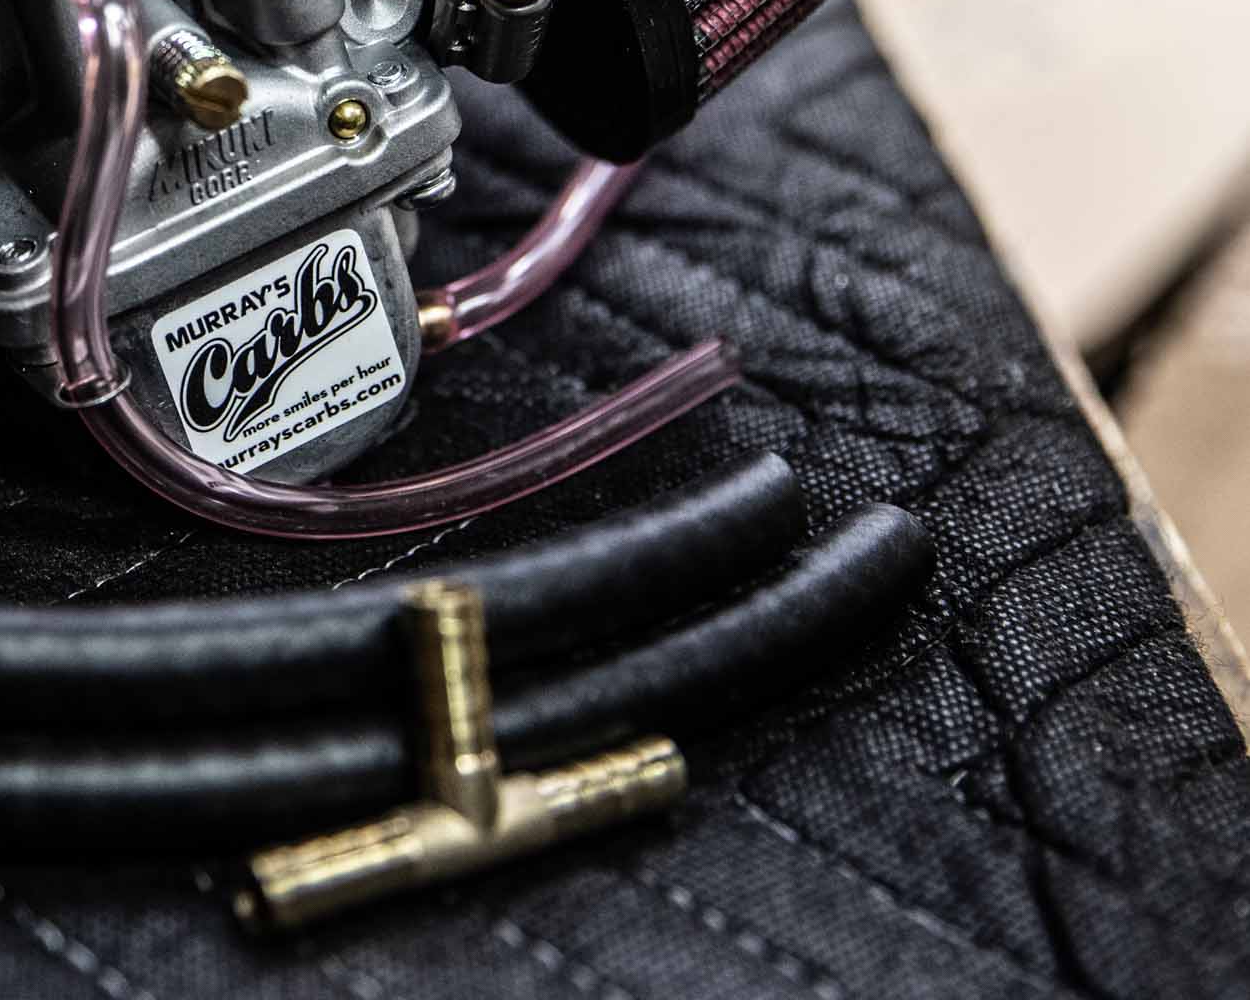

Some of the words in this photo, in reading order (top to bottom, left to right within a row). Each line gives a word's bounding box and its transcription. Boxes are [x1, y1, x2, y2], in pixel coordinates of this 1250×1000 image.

[164, 275, 292, 353] MURRAY'S
[180, 243, 378, 442] Carbs
[217, 373, 401, 470] urrayscarbs.com
[242, 413, 281, 438] more
[283, 387, 328, 417] smiles
[331, 375, 355, 397] per
[356, 355, 391, 380] hour
